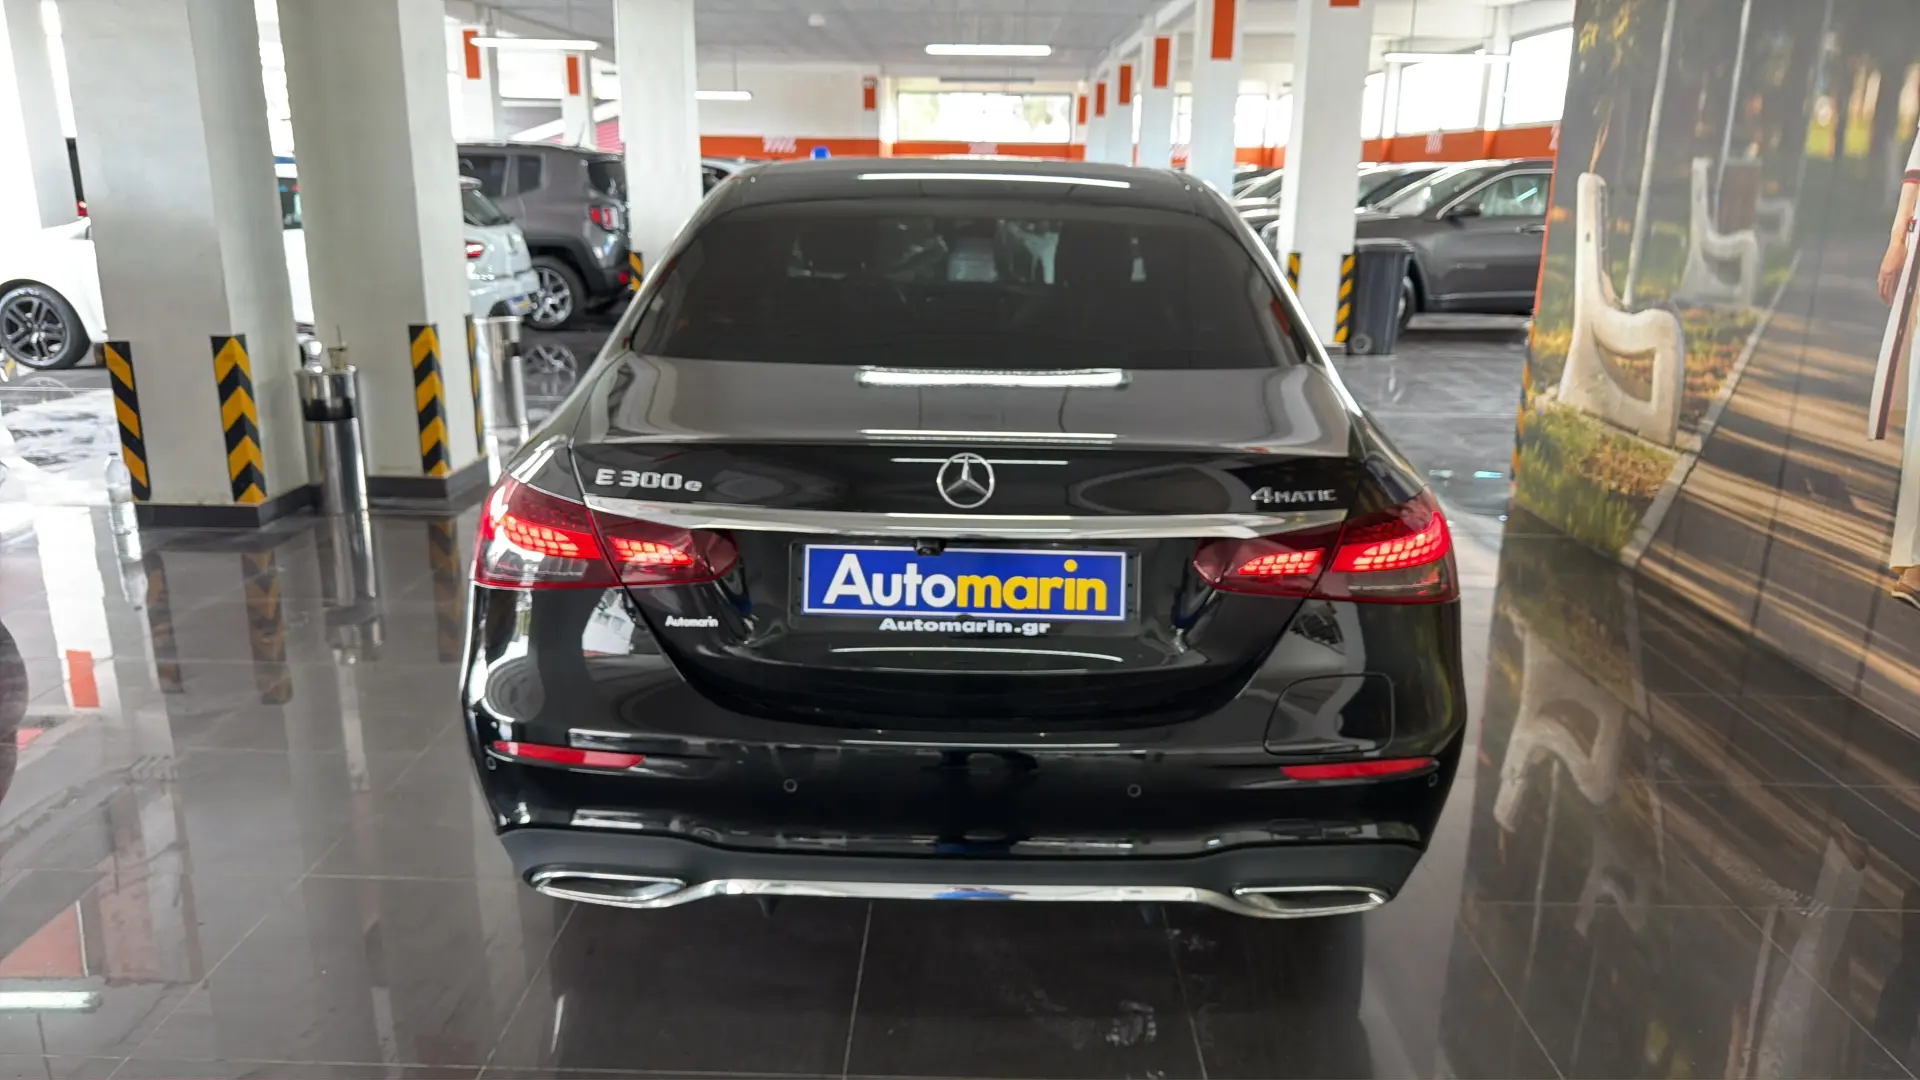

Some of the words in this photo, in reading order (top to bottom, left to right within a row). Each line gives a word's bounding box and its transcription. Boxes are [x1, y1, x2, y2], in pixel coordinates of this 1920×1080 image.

[595, 468, 614, 486] E
[618, 470, 703, 492] 300e
[1250, 485, 1339, 504] 4MATIC
[822, 552, 1107, 612] Automarin
[665, 615, 719, 628] Automarin
[879, 617, 1051, 637] Automarin.gr
